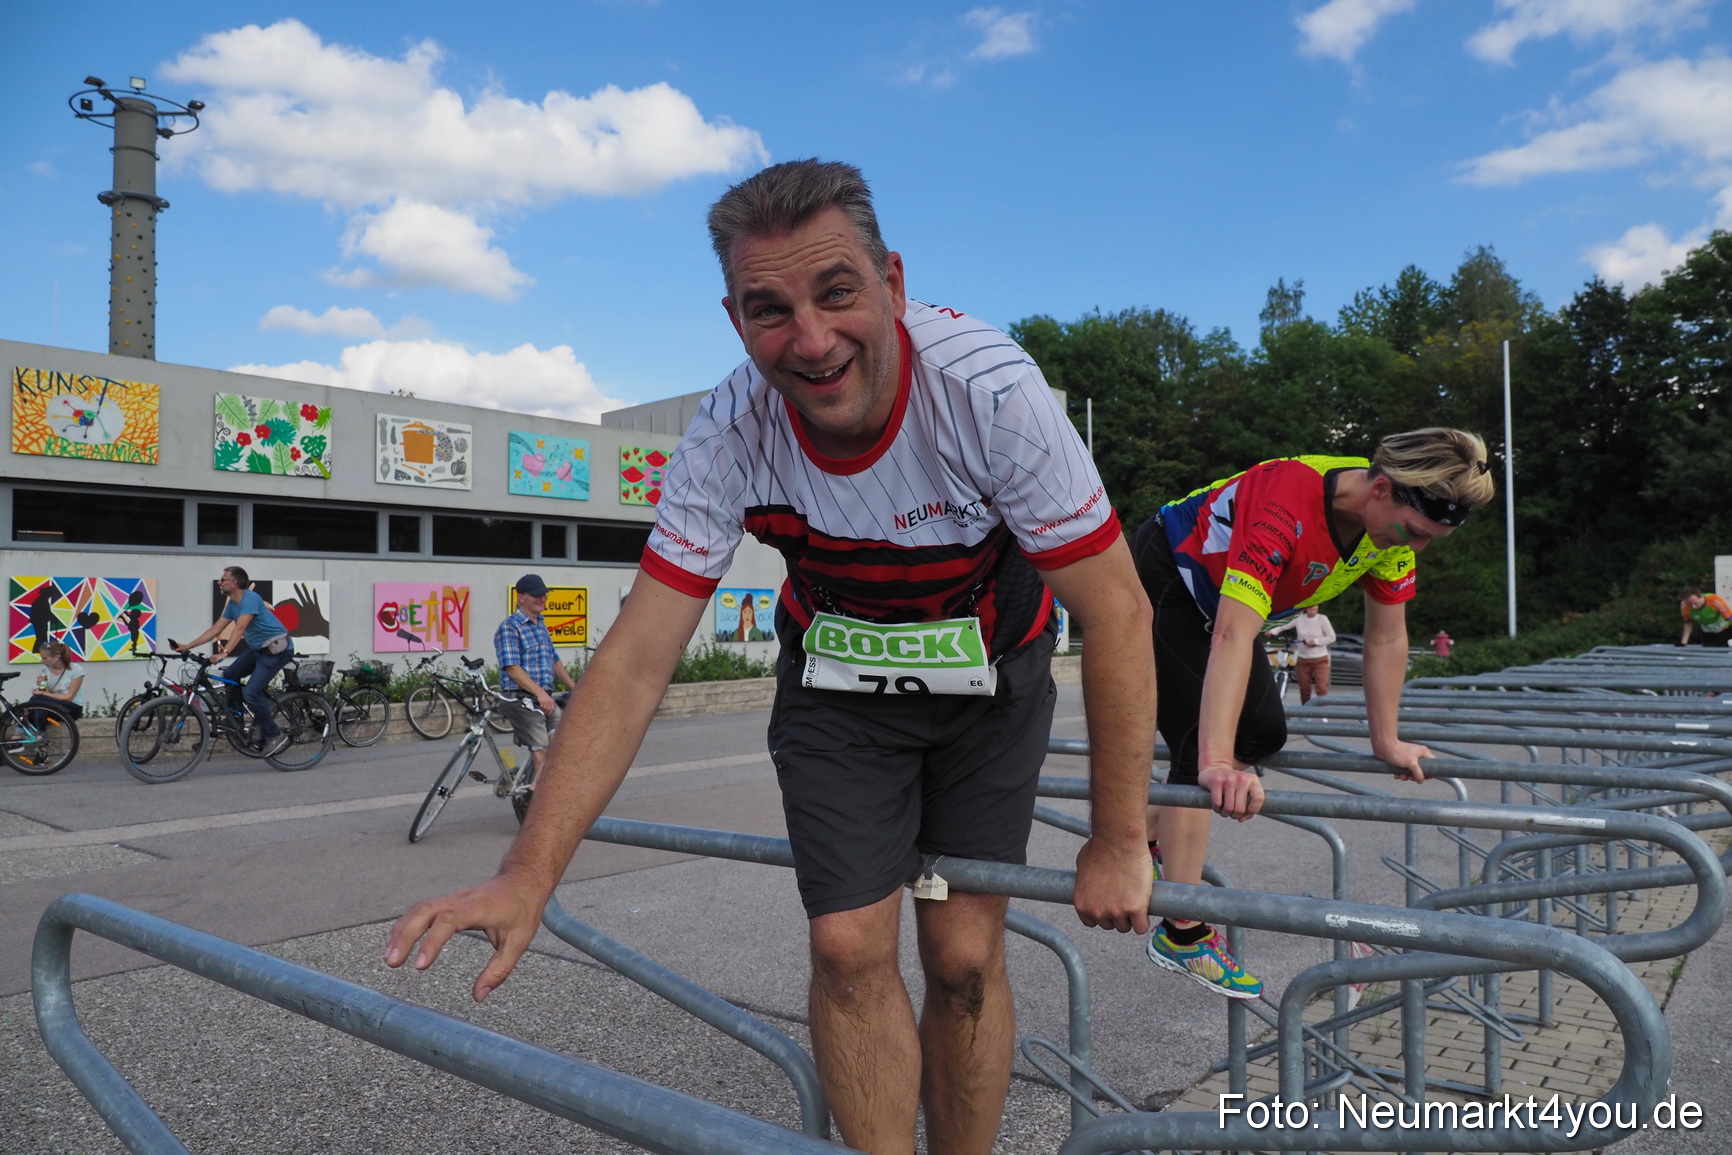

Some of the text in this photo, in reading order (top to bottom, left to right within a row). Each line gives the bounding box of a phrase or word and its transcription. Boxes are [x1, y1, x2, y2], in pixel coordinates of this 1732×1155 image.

[15, 366, 129, 408] KUNST
[893, 500, 980, 530] NEUMARKT
[816, 622, 970, 664] BOCK
